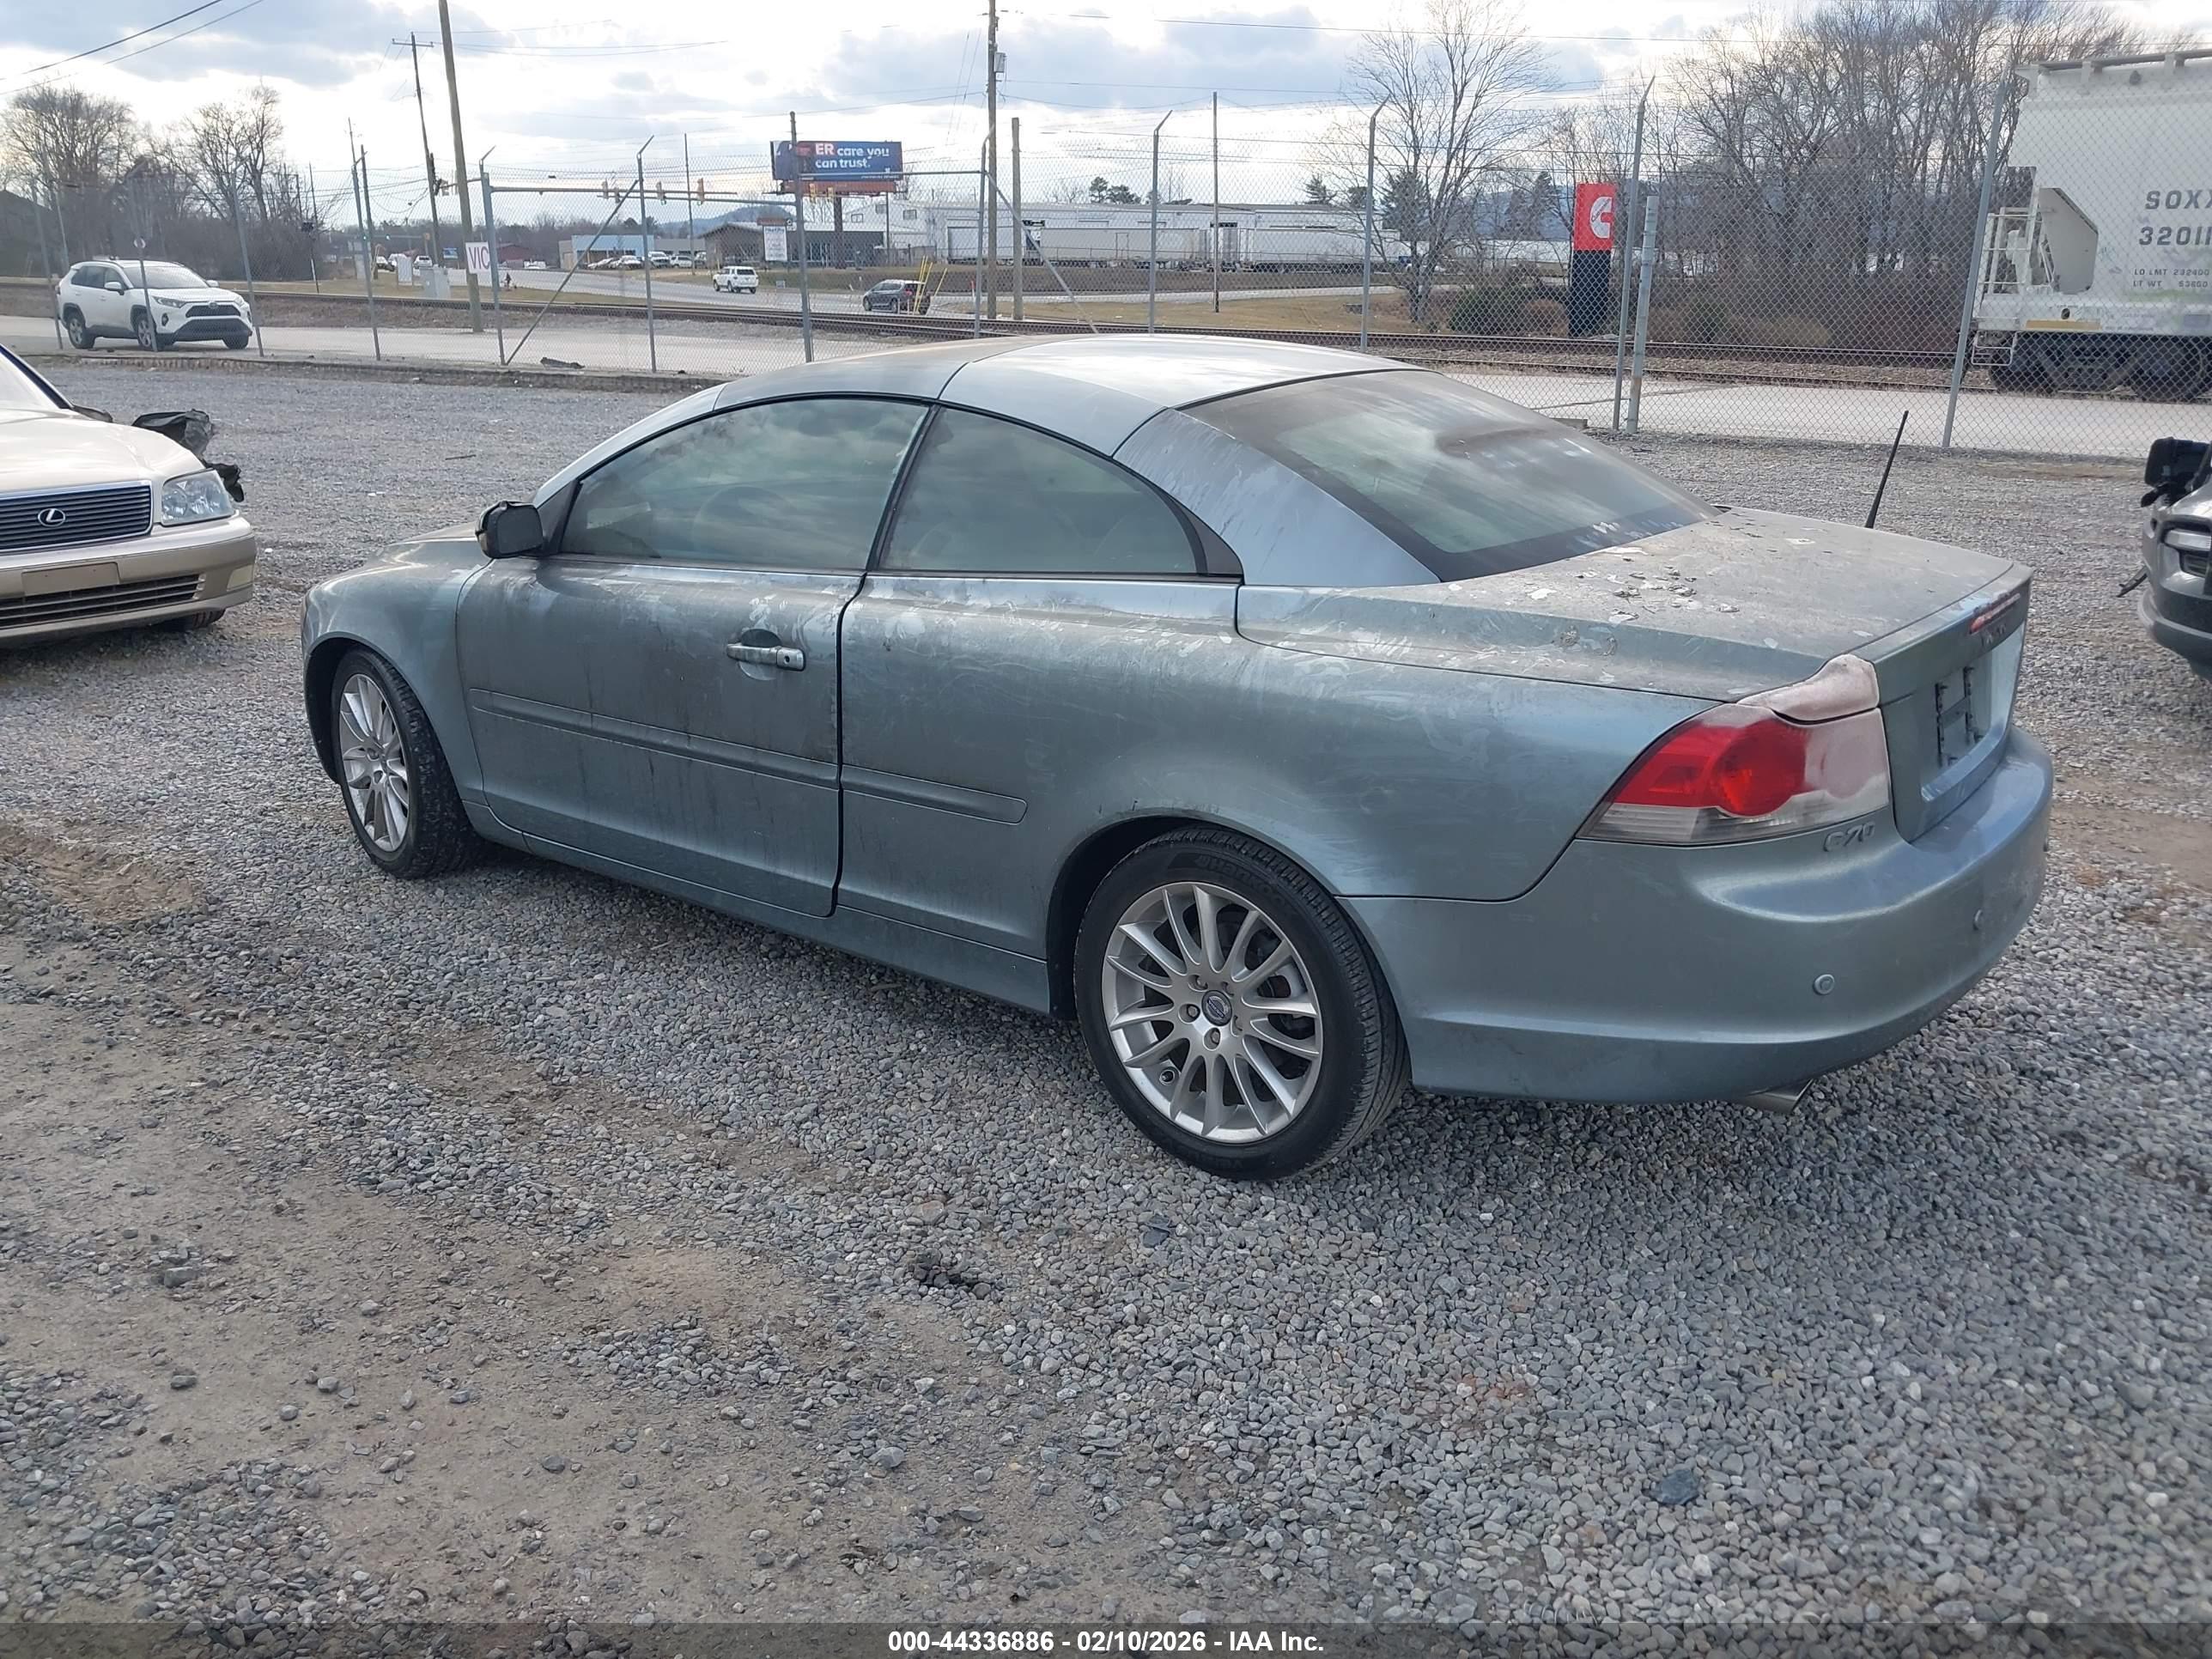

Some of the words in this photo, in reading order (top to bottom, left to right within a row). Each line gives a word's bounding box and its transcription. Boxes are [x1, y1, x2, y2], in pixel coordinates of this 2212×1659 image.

[815, 143, 835, 155] ER
[837, 148, 864, 156] care
[867, 148, 890, 160] you
[815, 160, 837, 168] can
[840, 159, 871, 168] trust.
[468, 246, 490, 270] VIC
